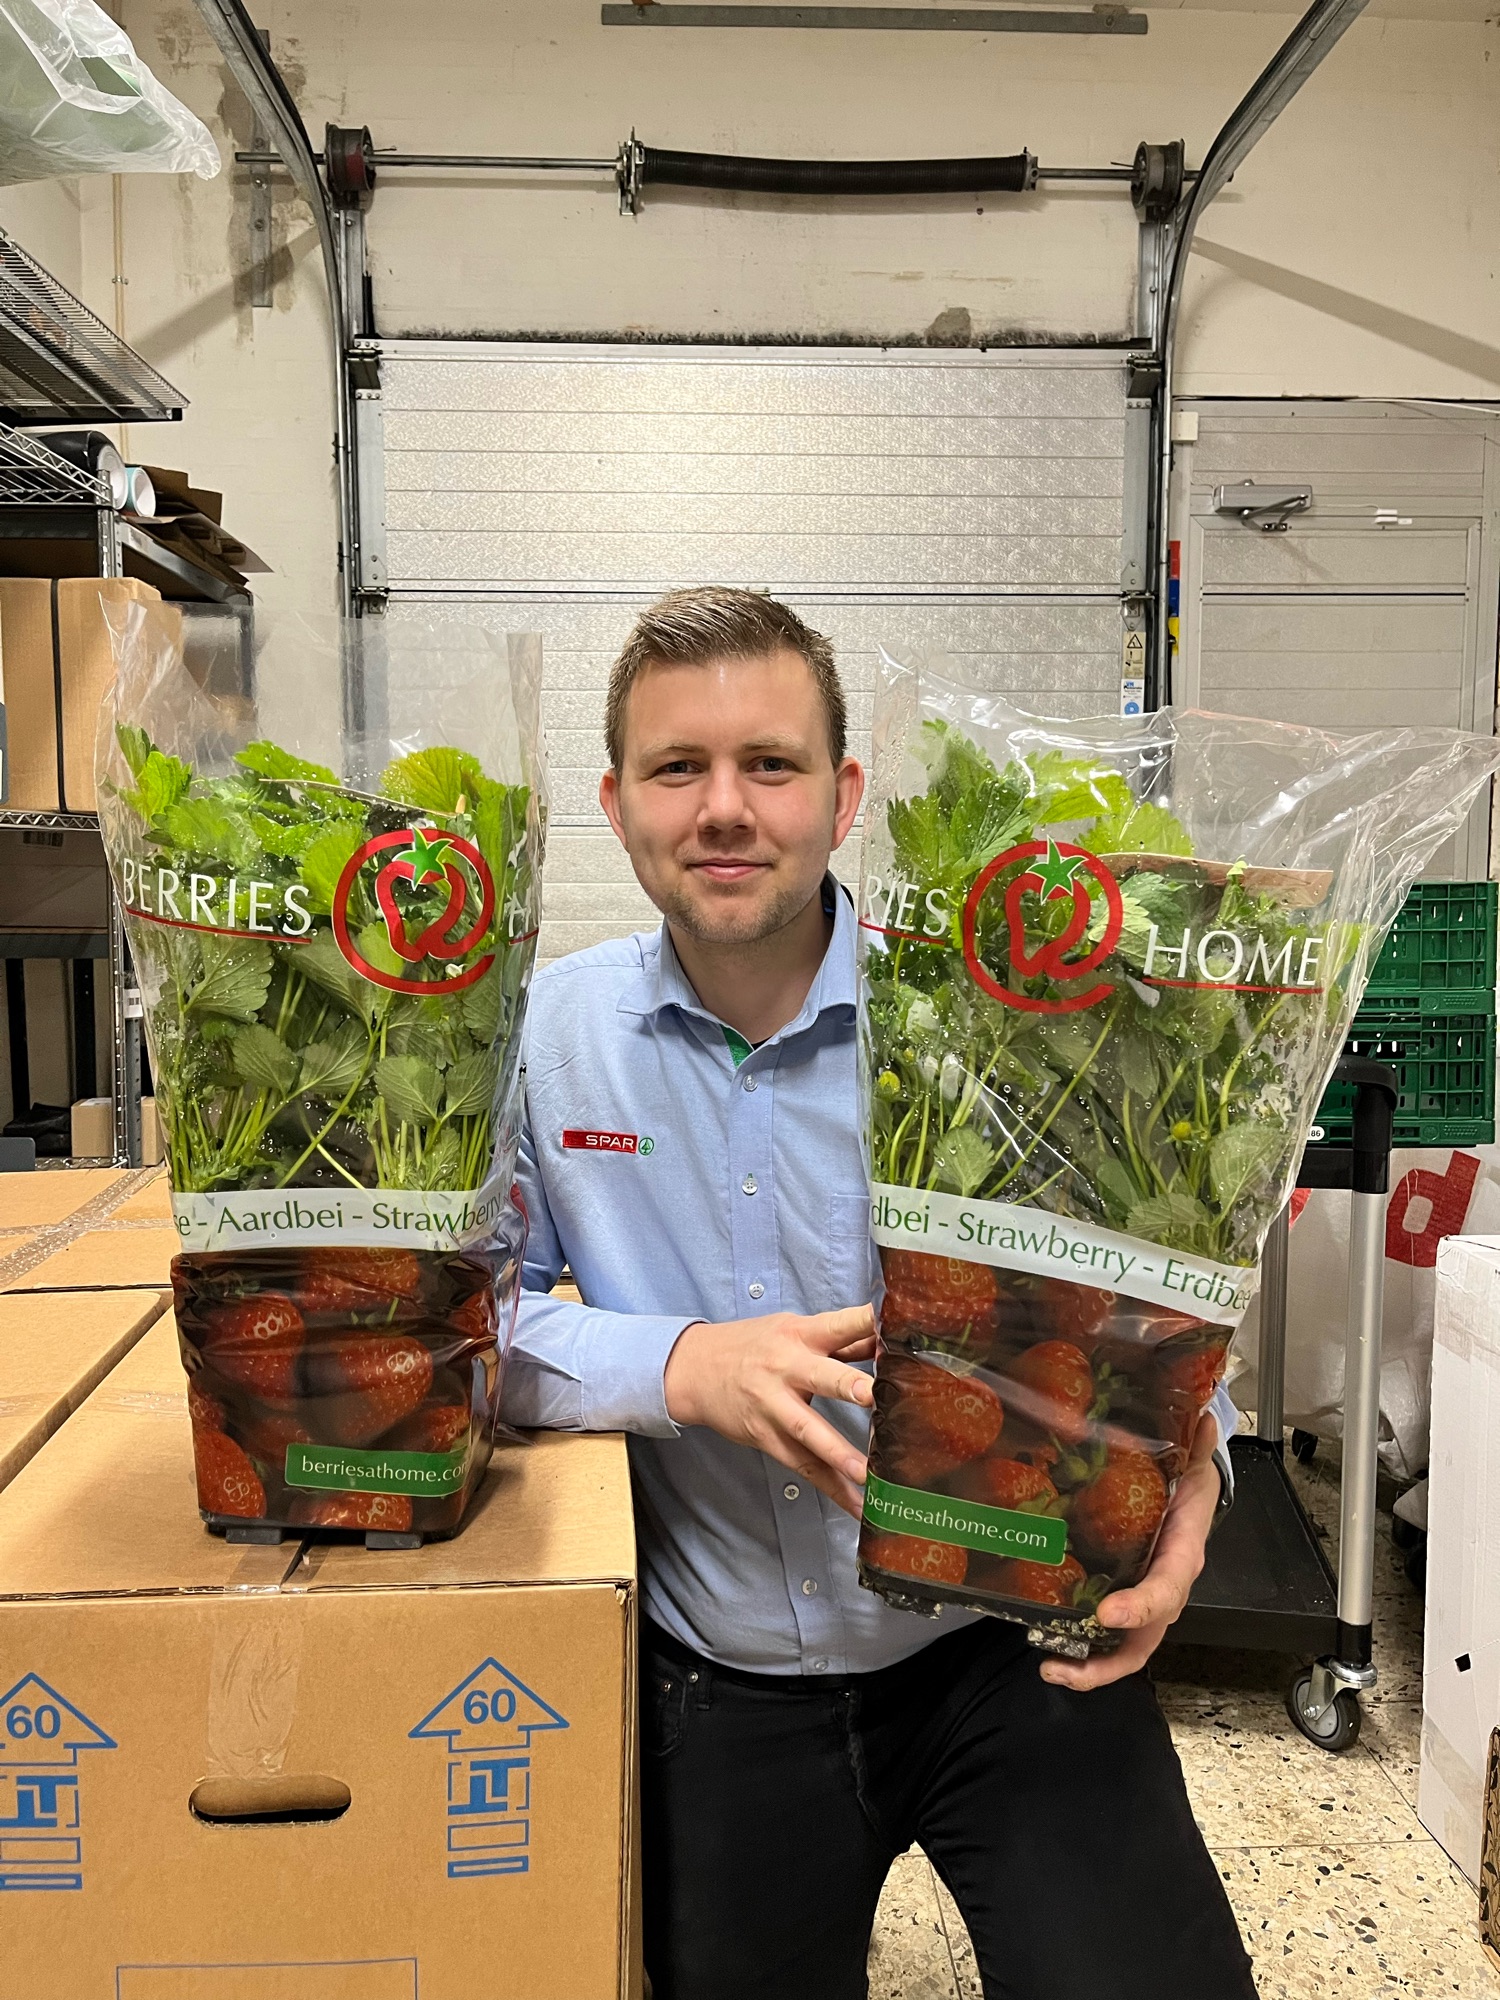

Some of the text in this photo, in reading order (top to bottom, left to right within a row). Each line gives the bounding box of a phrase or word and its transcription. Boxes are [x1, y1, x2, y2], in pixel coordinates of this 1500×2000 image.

[124, 858, 312, 935] BERRIES
[1143, 925, 1323, 986] HOME
[586, 1134, 634, 1149] SPAR
[217, 1200, 343, 1233] Aardbei
[957, 1212, 1136, 1283] Strawberry
[866, 1485, 1048, 1548] berriesathome.com
[6, 1704, 61, 1739] 60
[463, 1688, 517, 1725] 60
